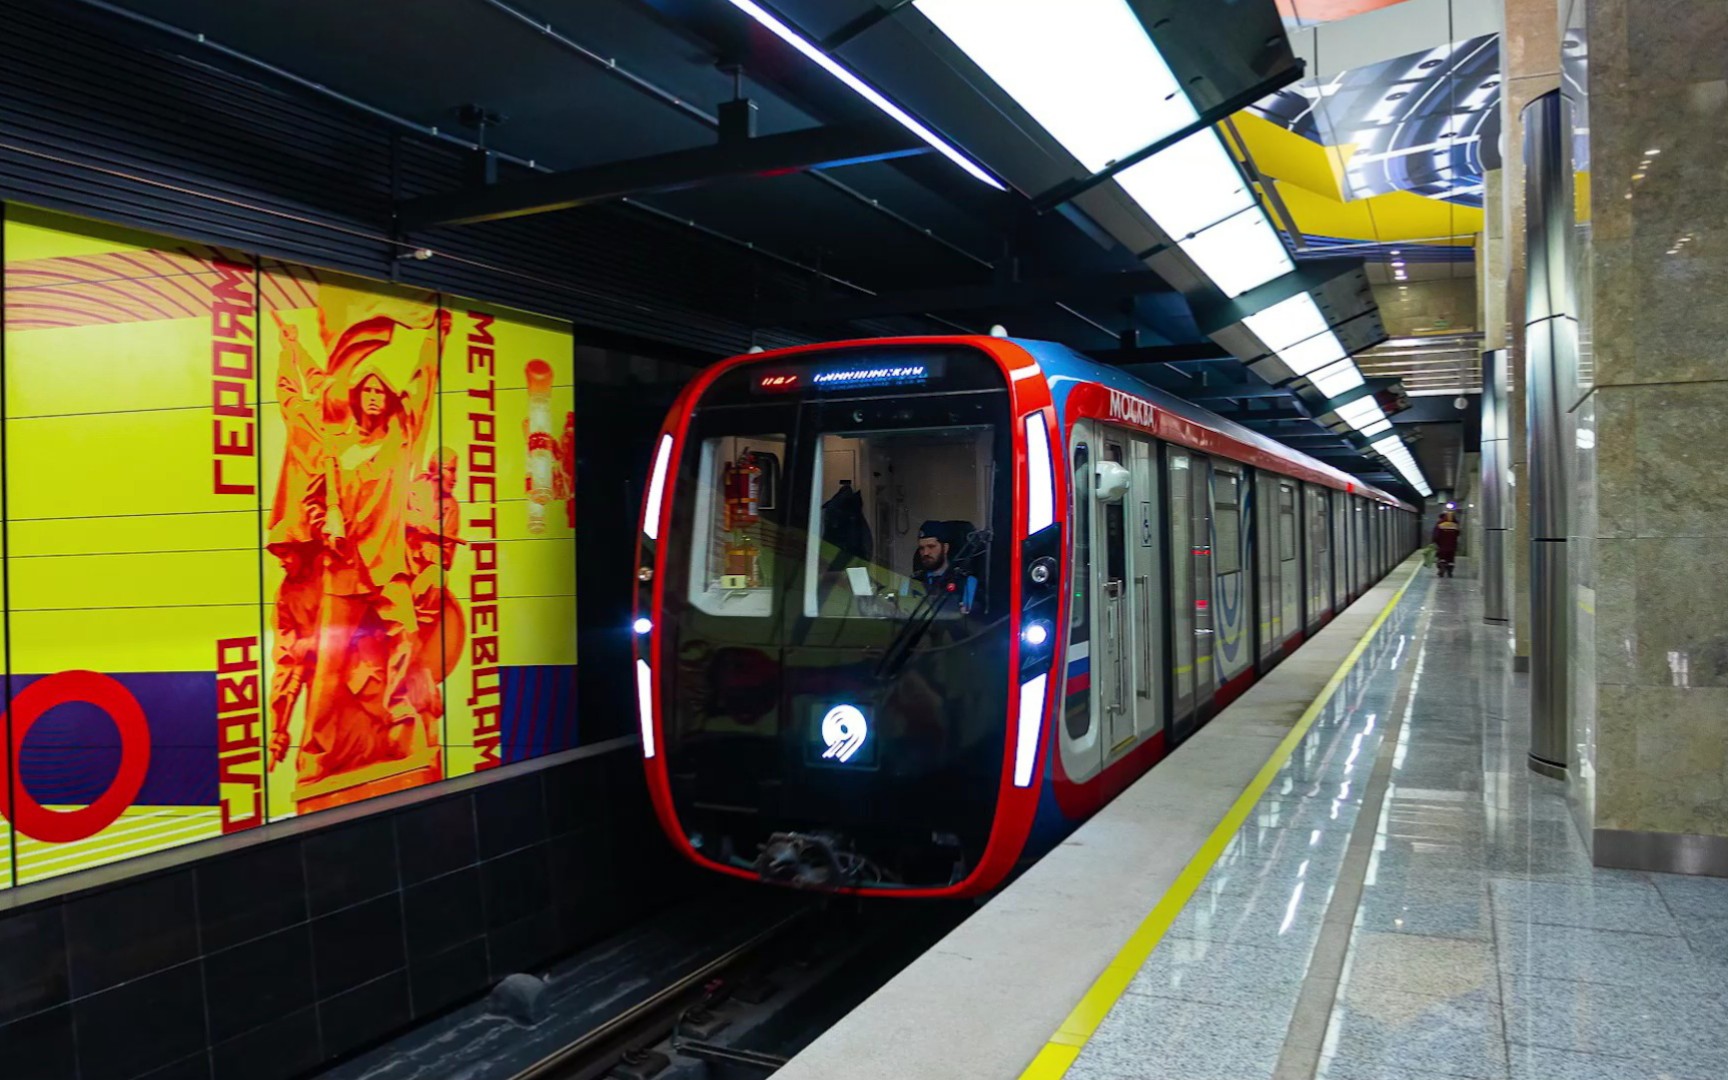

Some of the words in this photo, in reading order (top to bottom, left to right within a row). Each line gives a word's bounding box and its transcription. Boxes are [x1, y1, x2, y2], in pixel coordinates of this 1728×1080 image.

[212, 260, 256, 495] ГЕРОЯМ
[466, 310, 501, 771] МЕТРОСТРОЕВЦАМ
[216, 636, 262, 835] СЛАВА
